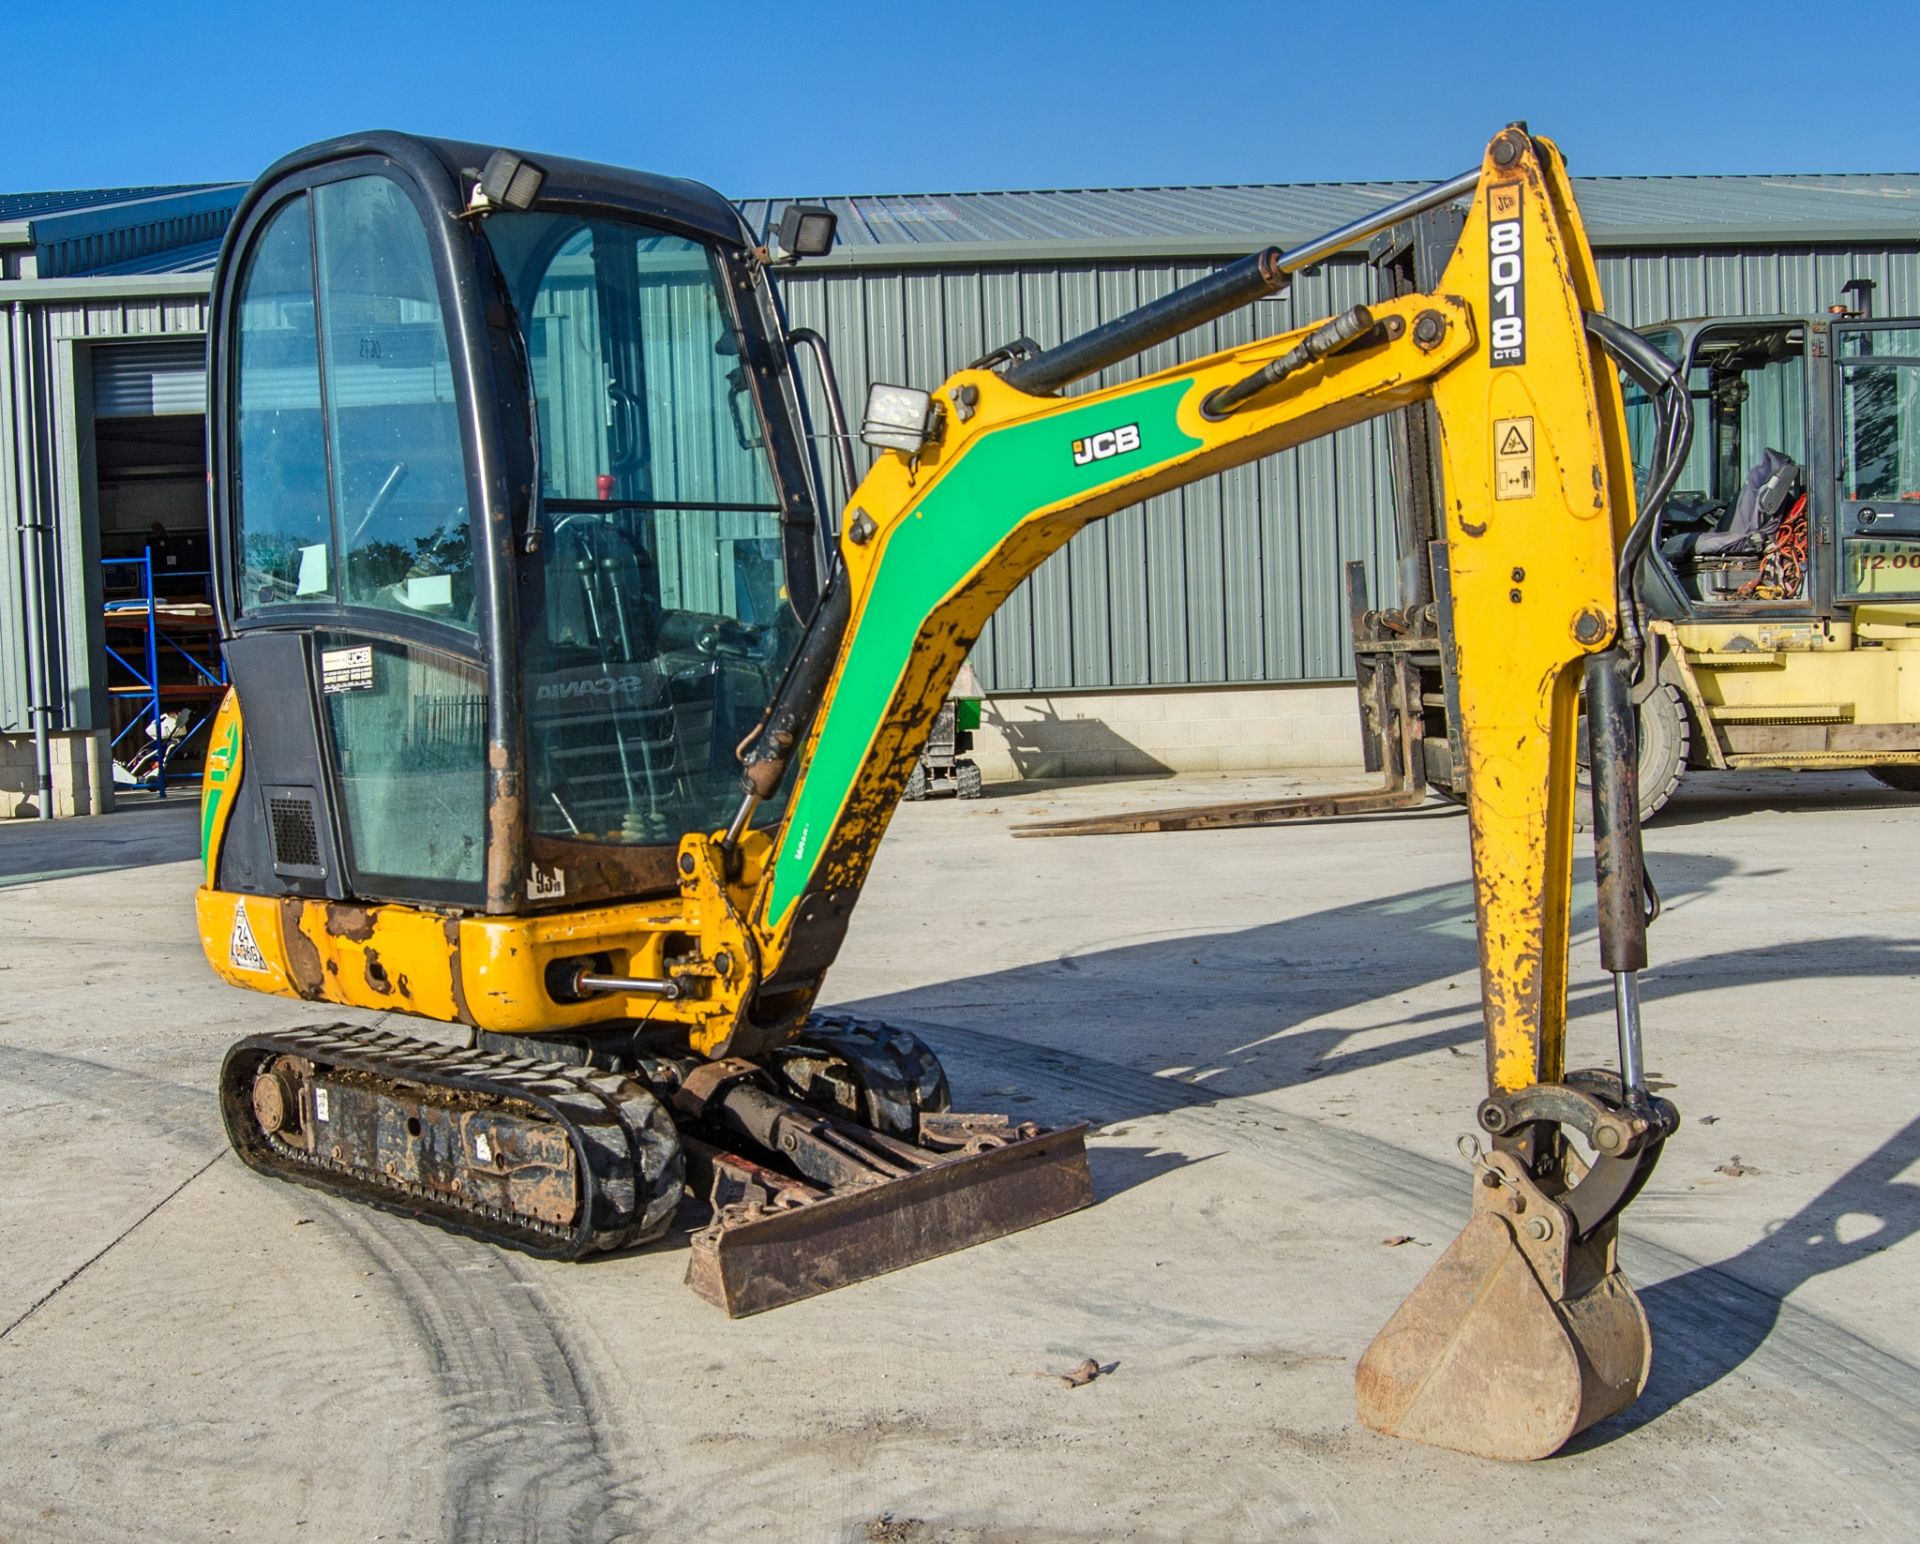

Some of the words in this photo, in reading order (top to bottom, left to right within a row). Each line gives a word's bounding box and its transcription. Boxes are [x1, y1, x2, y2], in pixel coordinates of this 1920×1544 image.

[1497, 195, 1515, 211] JCB
[1491, 222, 1522, 349] 8018
[1494, 348, 1521, 360] CTS
[1073, 424, 1141, 466] JCB
[348, 650, 370, 665] JCB
